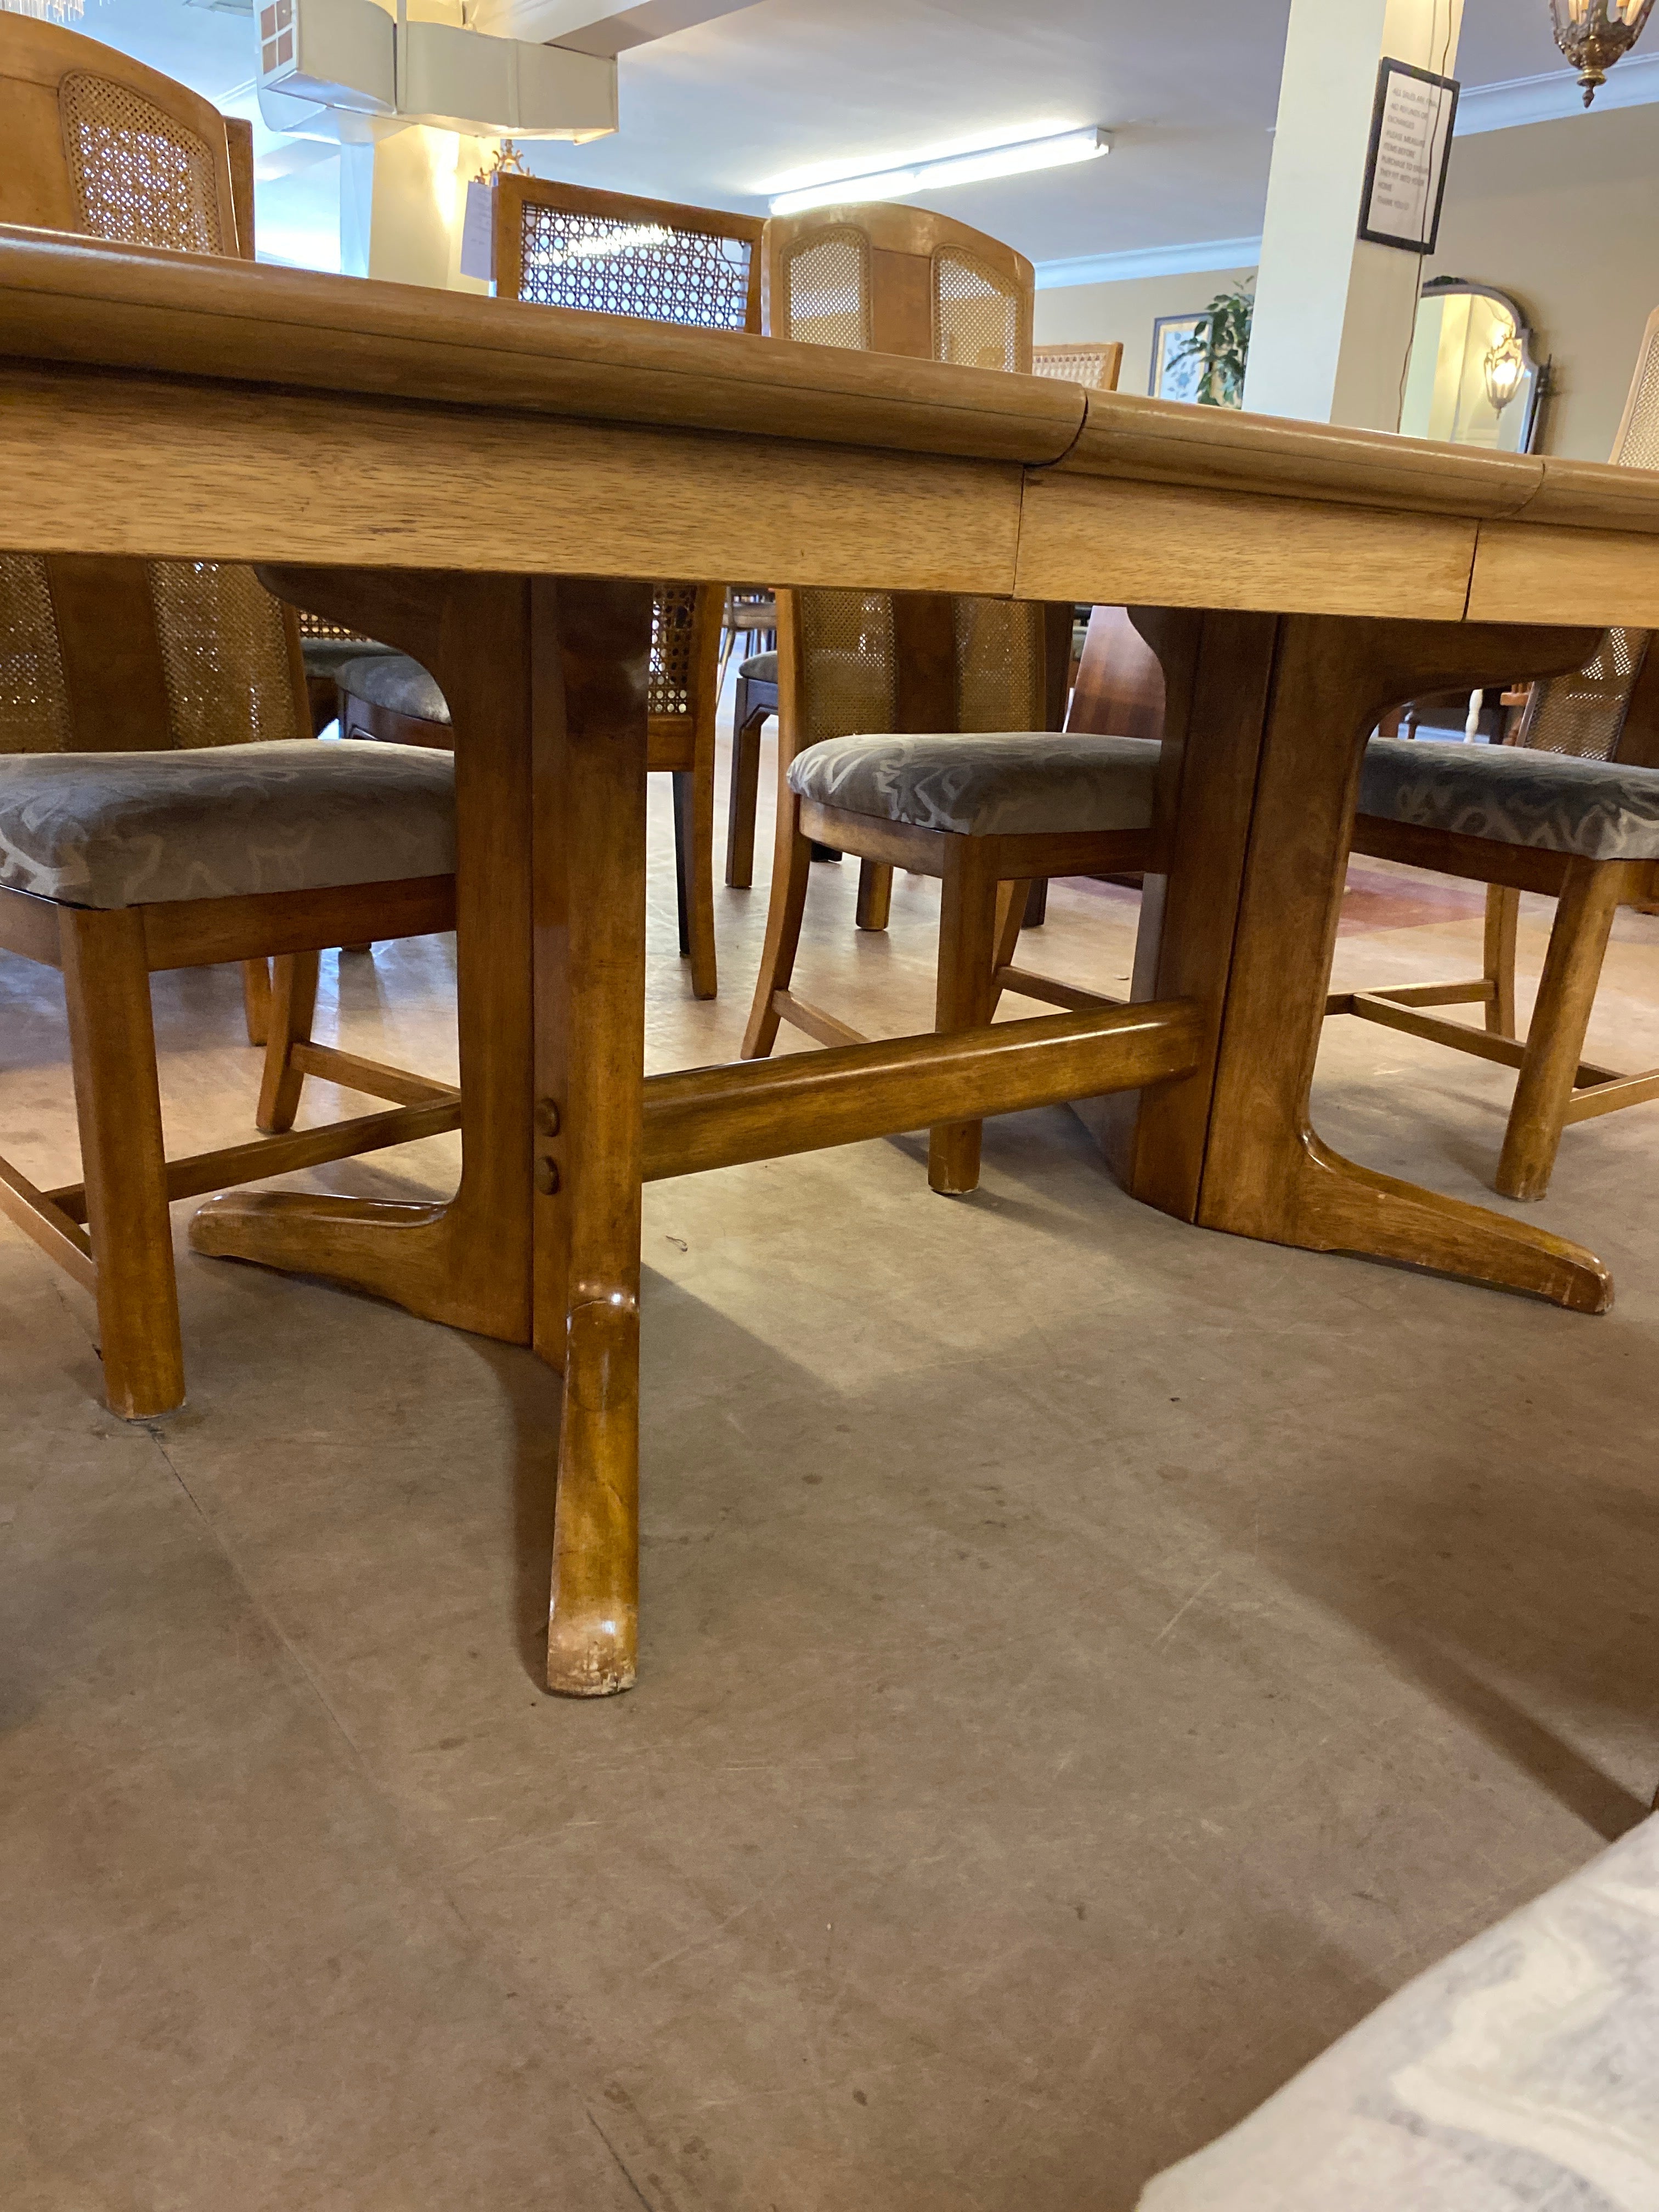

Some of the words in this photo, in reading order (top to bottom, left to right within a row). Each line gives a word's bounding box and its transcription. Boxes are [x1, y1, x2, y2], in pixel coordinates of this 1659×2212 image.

[1386, 129, 1403, 141] PLEASE
[1398, 147, 1414, 158] BEFORE
[1381, 155, 1405, 169] PURCHASE
[1406, 162, 1413, 171] TO
